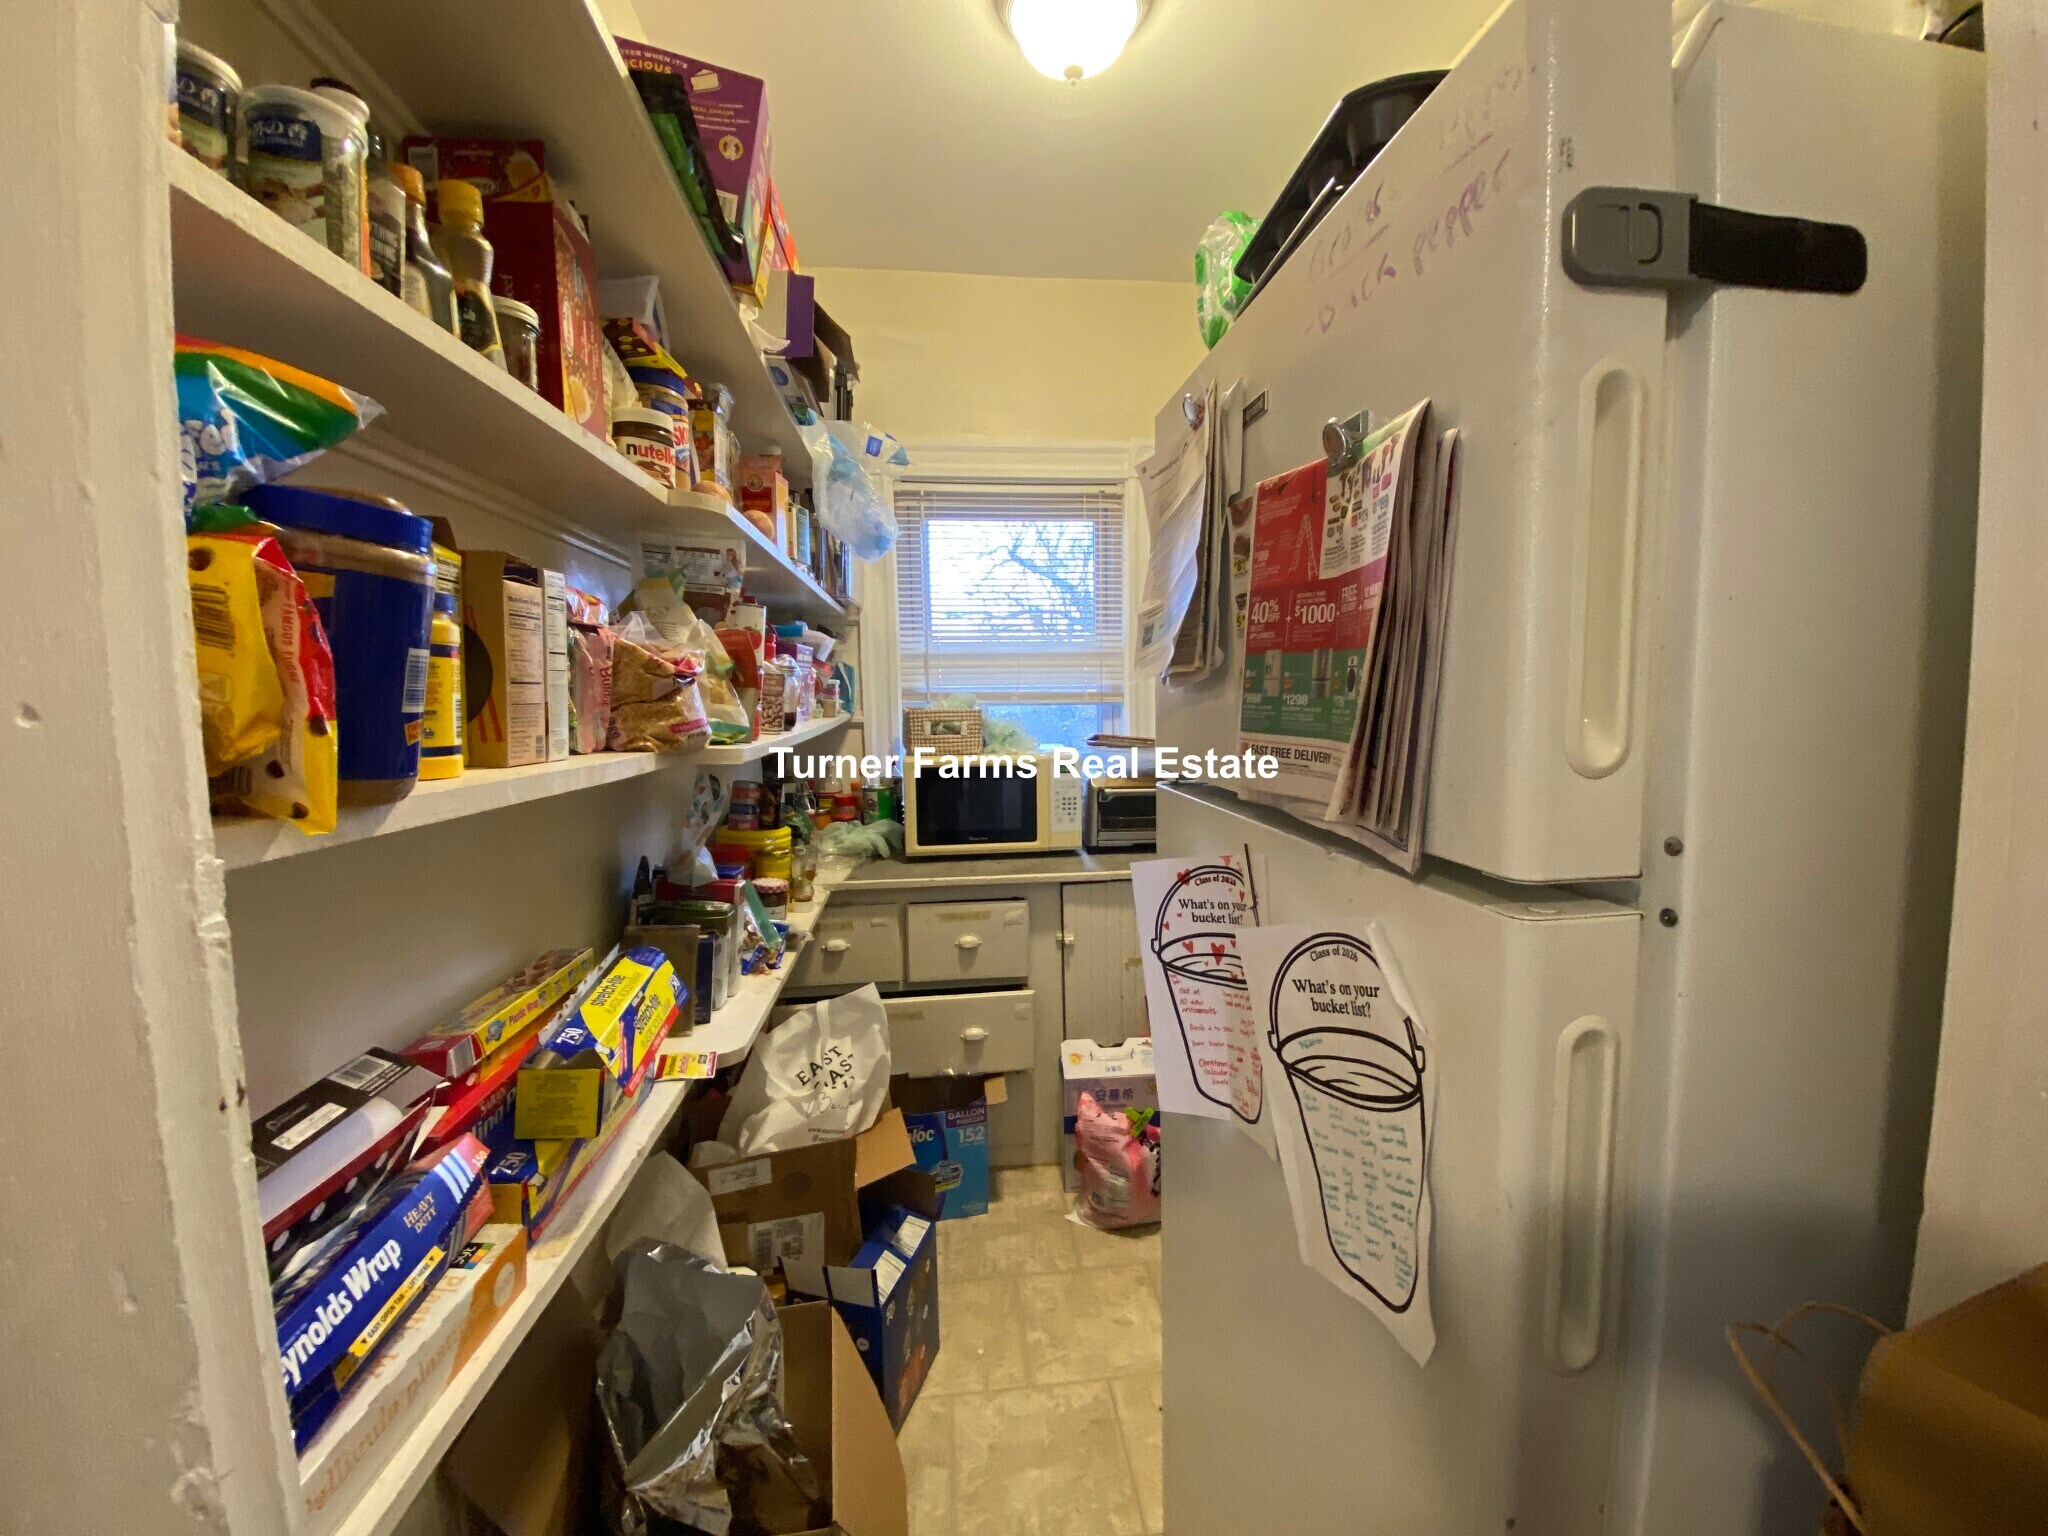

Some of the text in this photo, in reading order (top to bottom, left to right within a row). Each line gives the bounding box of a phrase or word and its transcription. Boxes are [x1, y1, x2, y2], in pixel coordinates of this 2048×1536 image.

[644, 51, 670, 63] WHEN
[1342, 584, 1358, 604] FREE
[1294, 602, 1336, 625] $1000
[281, 602, 294, 648] FAMOUS
[1270, 746, 1292, 759] FREE
[1294, 748, 1332, 765] DELIVERY
[1194, 875, 1212, 887] Class
[1212, 874, 1220, 882] of
[1178, 898, 1247, 916] What's on your
[1191, 911, 1243, 926] bucket list?
[1310, 945, 1359, 963] Class of 2026
[1292, 978, 1380, 1001] What's on your
[1310, 997, 1371, 1019] bucket list?
[555, 1027, 584, 1046] 750
[947, 1107, 985, 1120] GALLON
[909, 1127, 936, 1144] loc
[957, 1126, 985, 1144] 152
[490, 1151, 527, 1176] 750
[402, 1191, 436, 1229] HEAVY
[413, 1207, 437, 1234] DUTY
[341, 1238, 402, 1301] Wrap
[366, 1320, 382, 1339] EASY
[380, 1303, 396, 1324] OPEN
[393, 1291, 406, 1310] TAB
[406, 1275, 419, 1293] LIFT
